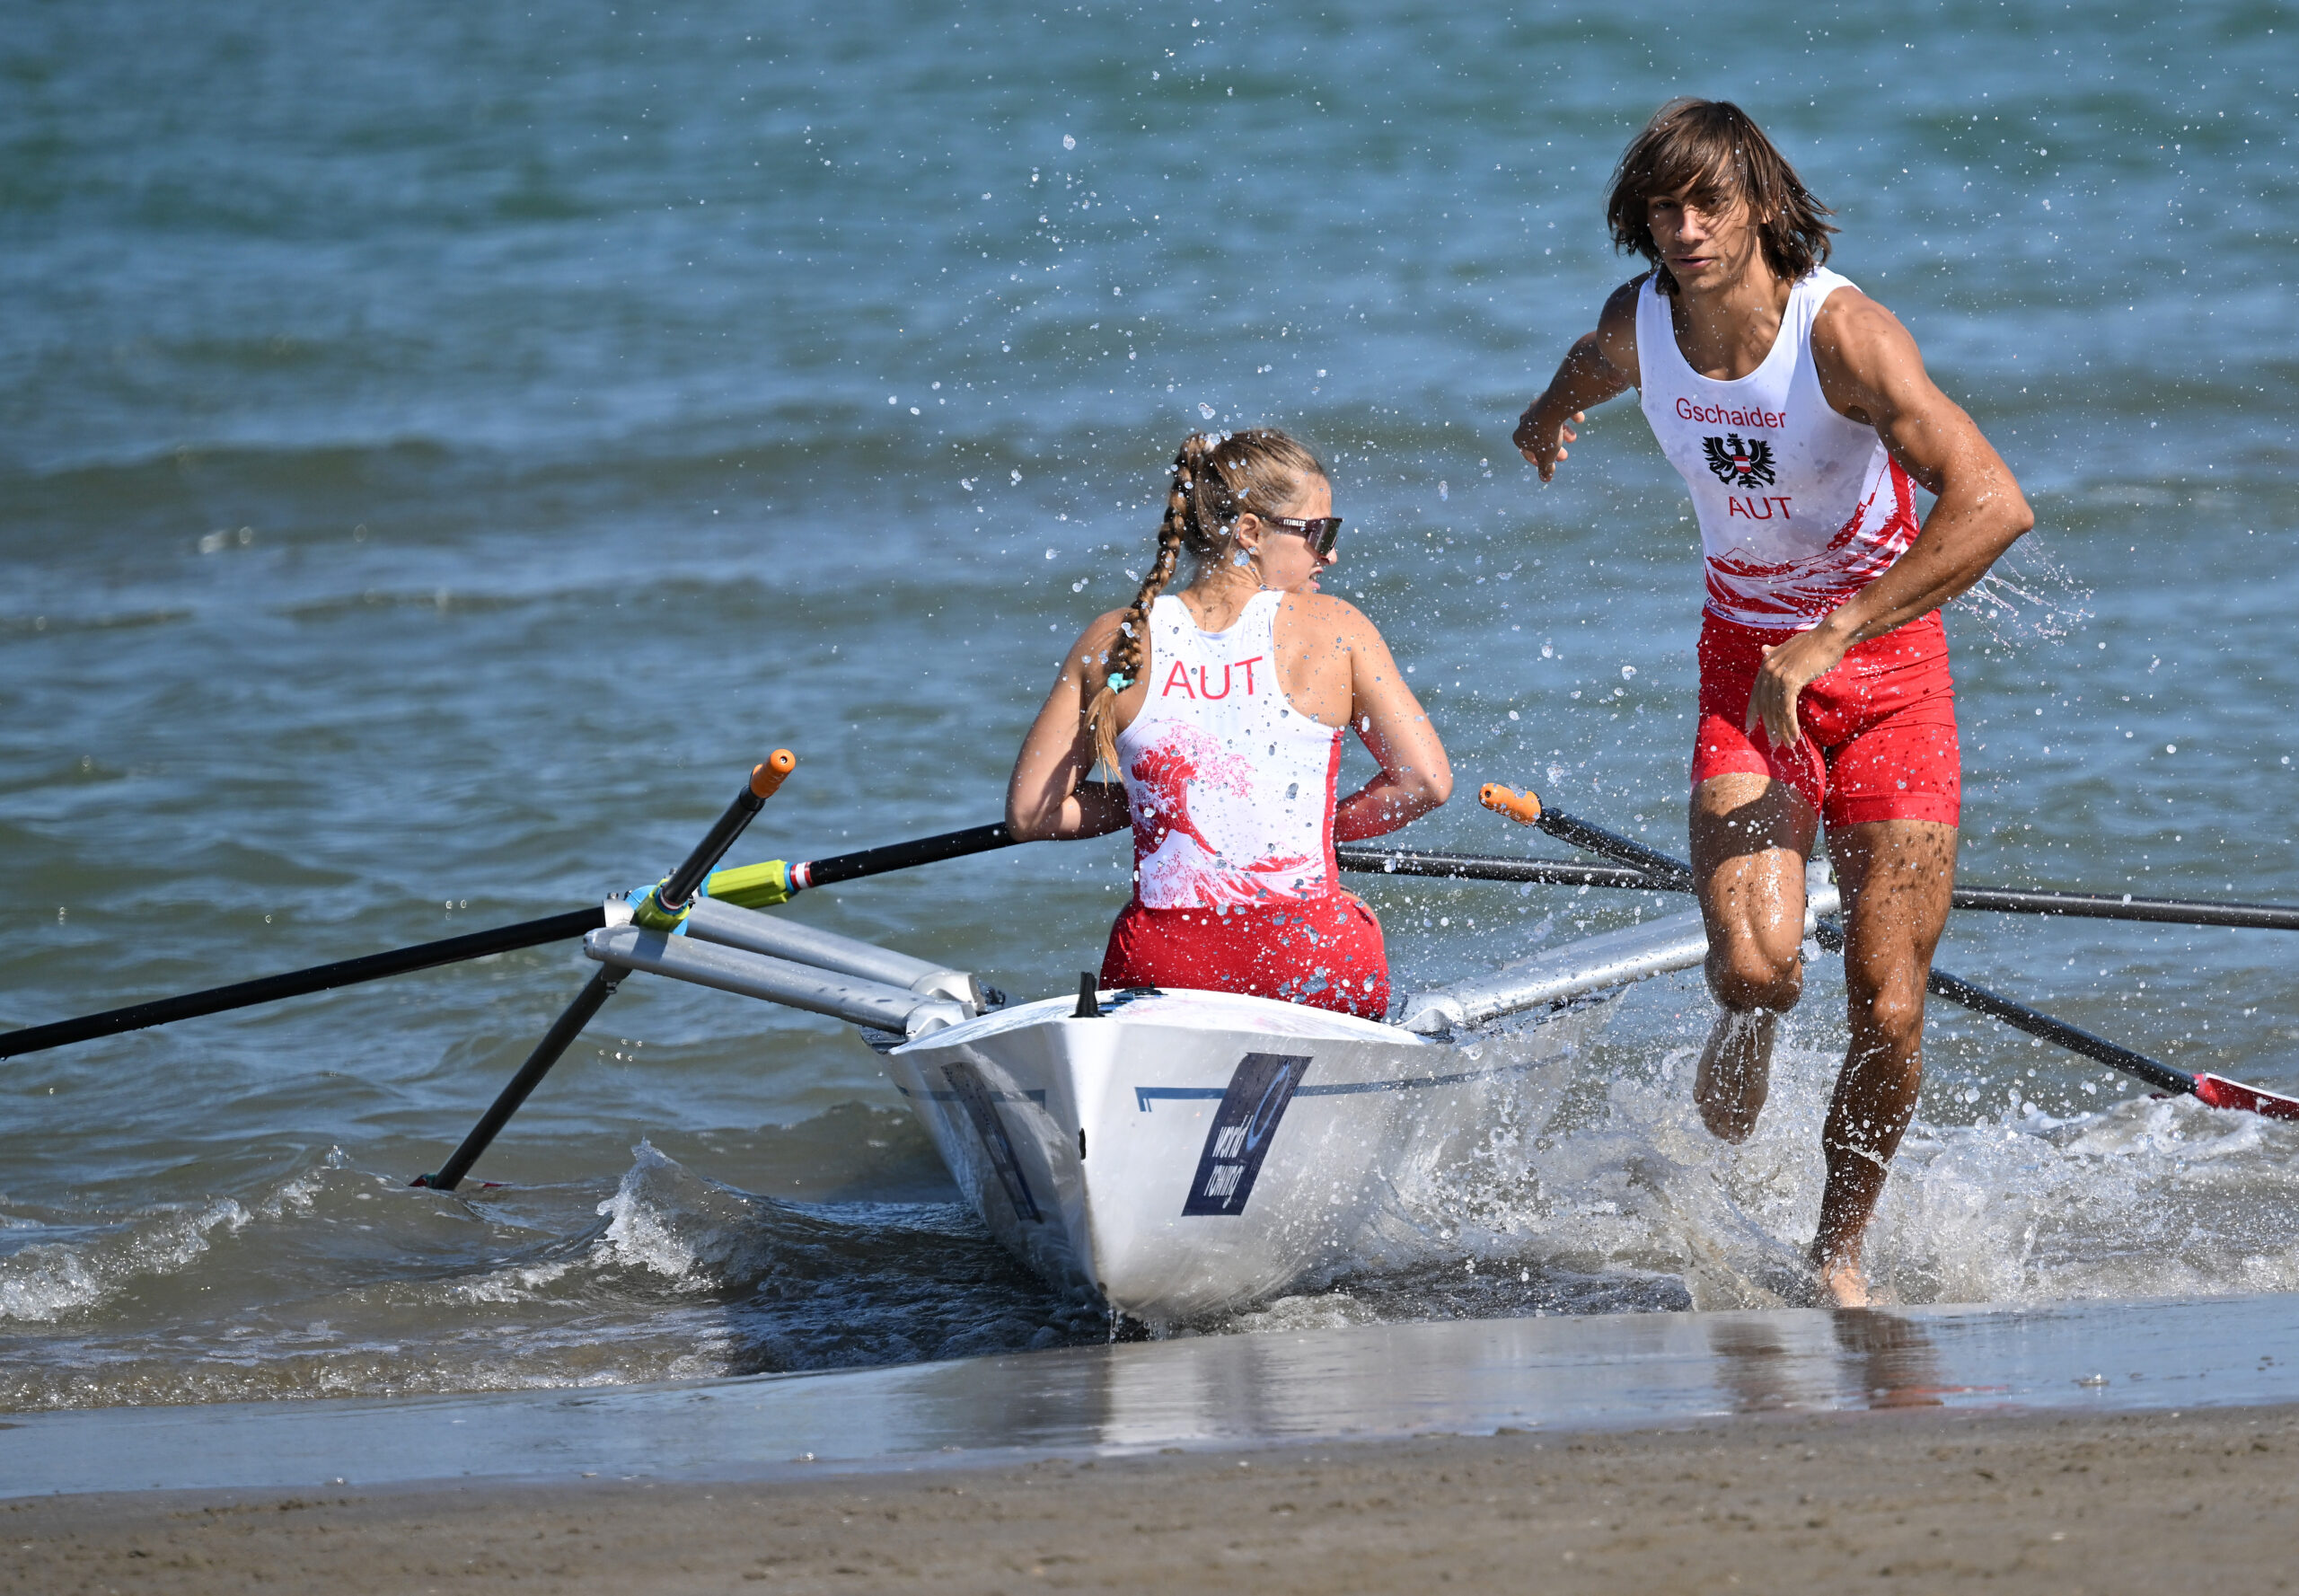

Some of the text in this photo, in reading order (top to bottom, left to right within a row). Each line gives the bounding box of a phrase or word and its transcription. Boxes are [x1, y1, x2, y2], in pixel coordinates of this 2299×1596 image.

[1676, 397, 1786, 428] Gschaider
[1728, 496, 1792, 520] AUT
[1161, 656, 1264, 701] AUT
[1211, 1114, 1254, 1159] world
[1203, 1164, 1246, 1209] rowing
